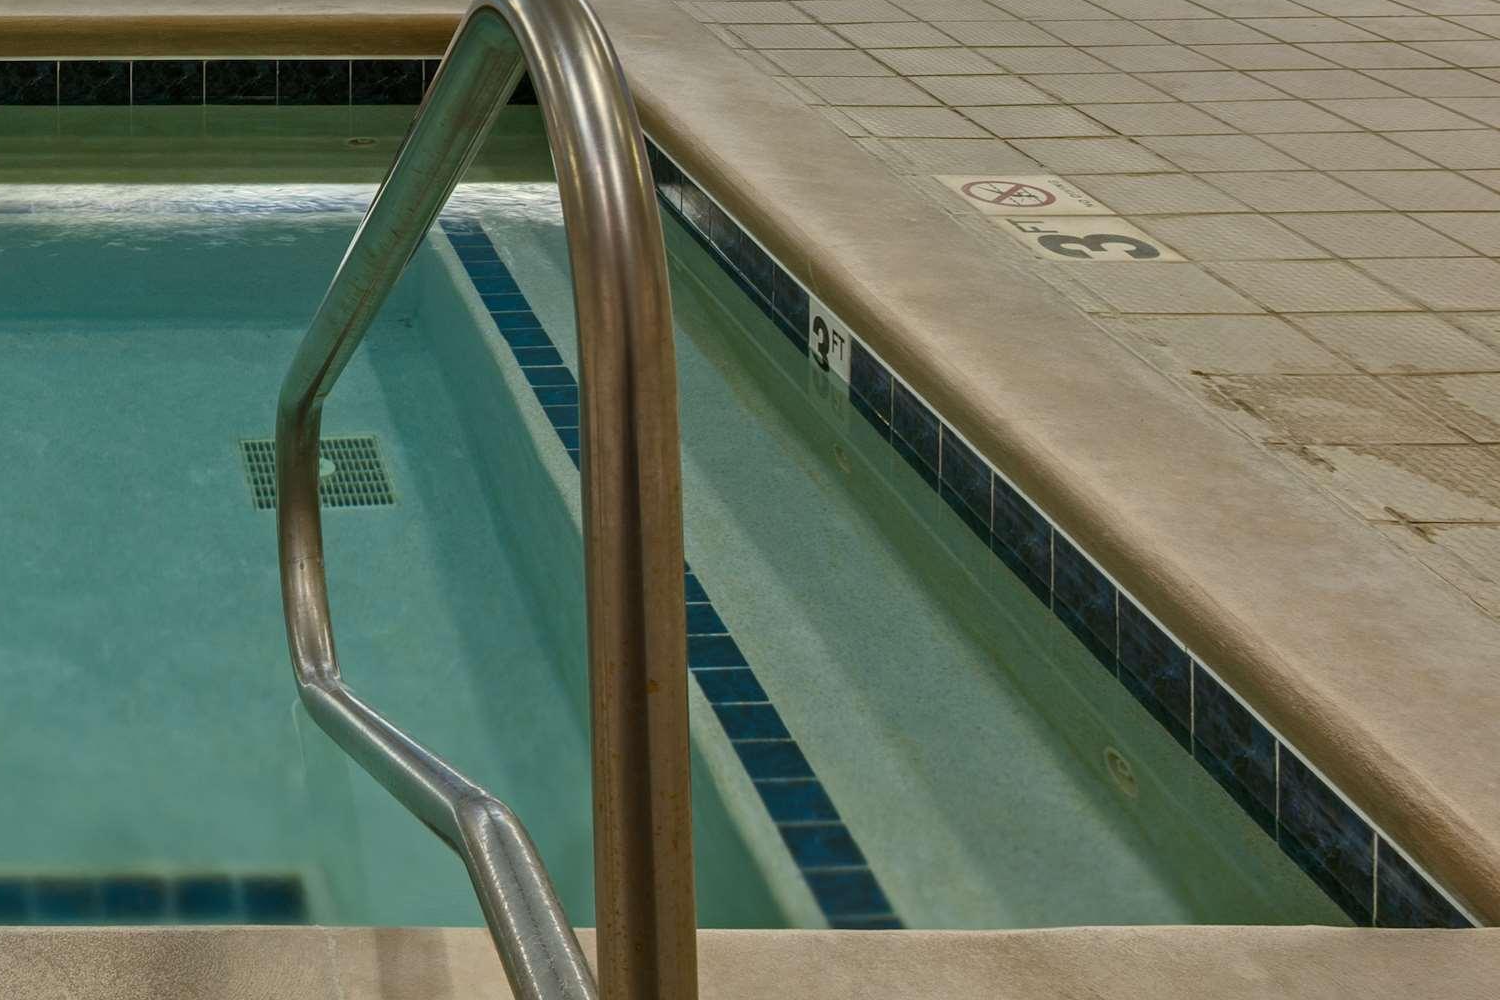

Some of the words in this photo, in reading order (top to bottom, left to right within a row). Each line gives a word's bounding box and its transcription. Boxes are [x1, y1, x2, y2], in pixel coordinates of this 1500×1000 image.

[1006, 218, 1059, 234] FT
[1037, 233, 1161, 260] 3
[832, 328, 845, 361] FT
